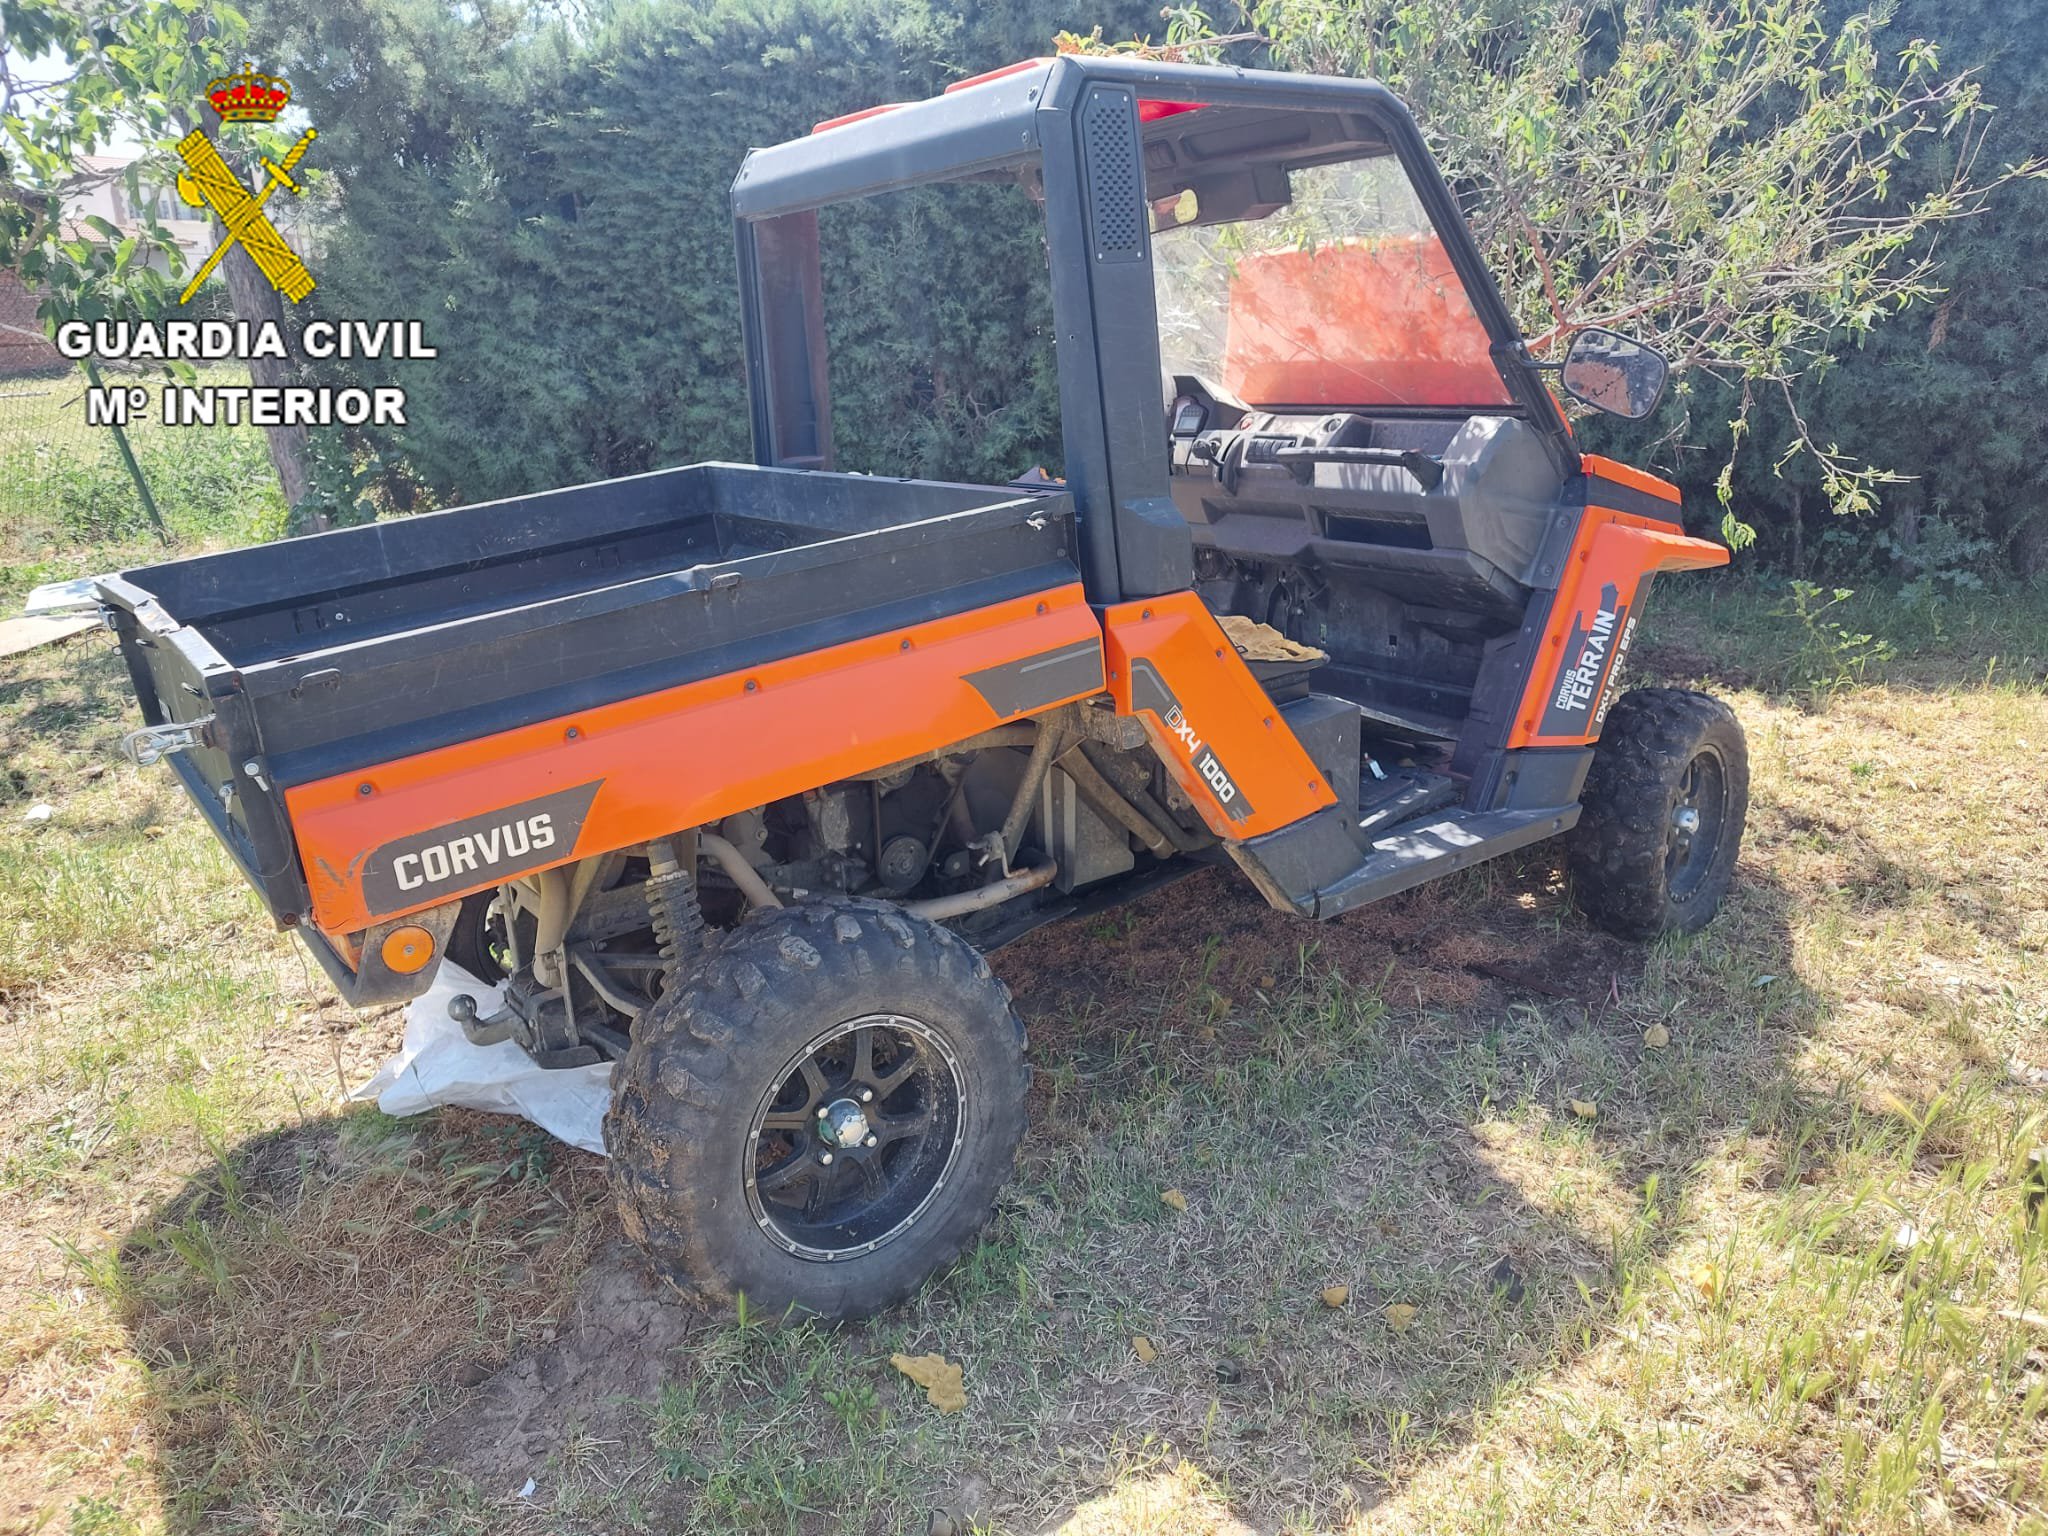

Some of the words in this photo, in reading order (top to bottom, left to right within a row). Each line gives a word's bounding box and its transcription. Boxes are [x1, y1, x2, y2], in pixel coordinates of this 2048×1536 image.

[1555, 669, 1577, 709] CORVUS
[1566, 609, 1617, 711] TERRAIN
[1595, 690, 1612, 723] DX4
[1607, 654, 1624, 687] PRO
[1620, 616, 1637, 651] EPS
[1164, 705, 1202, 754] DX4
[1199, 752, 1236, 803] 1000
[393, 813, 556, 891] CORVUS
